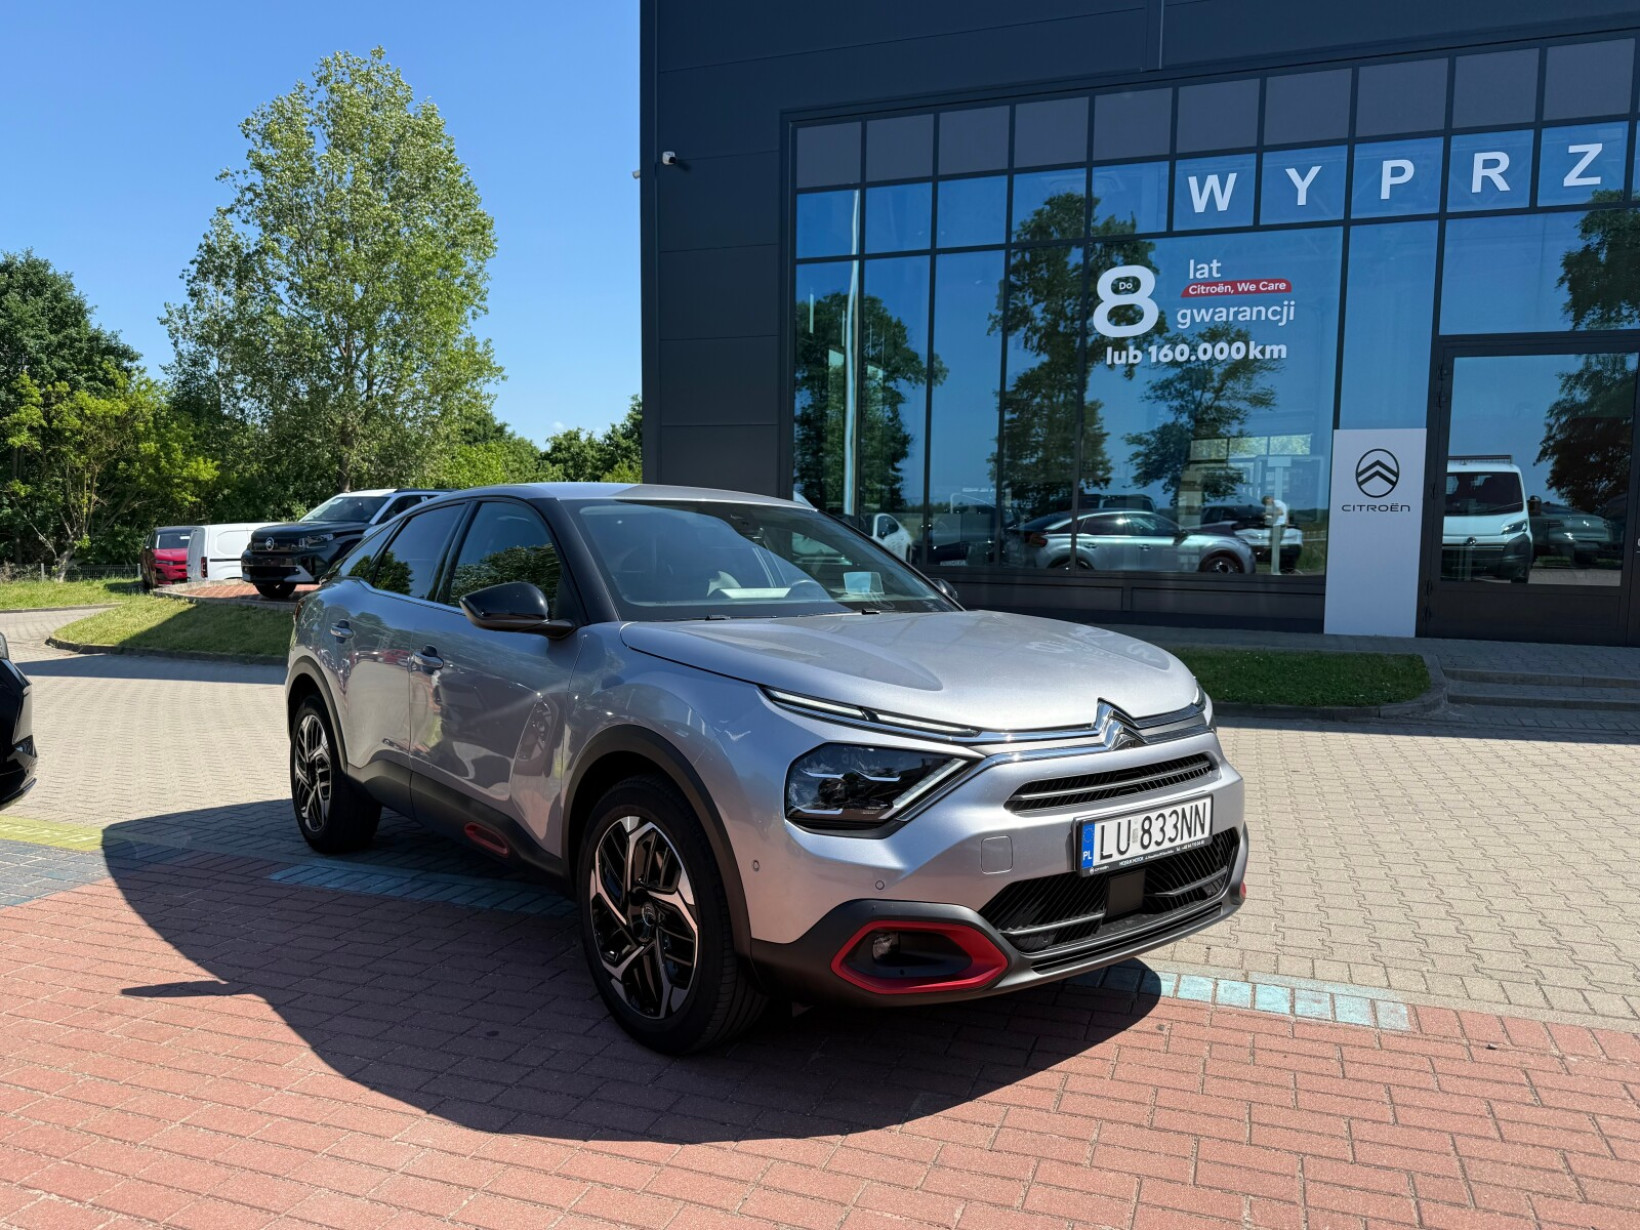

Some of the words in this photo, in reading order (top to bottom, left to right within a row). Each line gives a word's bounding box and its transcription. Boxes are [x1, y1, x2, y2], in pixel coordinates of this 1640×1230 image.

[1189, 259, 1222, 280] lat
[1118, 281, 1133, 290] Do
[1188, 282, 1235, 296] Citroën,
[1236, 281, 1257, 293] We
[1259, 280, 1287, 292] Care
[1093, 264, 1159, 338] 8
[1176, 301, 1296, 329] gwarancji
[1106, 346, 1143, 365] lub
[1100, 819, 1132, 861] LU
[1140, 802, 1207, 850] 833NN
[1082, 850, 1093, 861] PL
